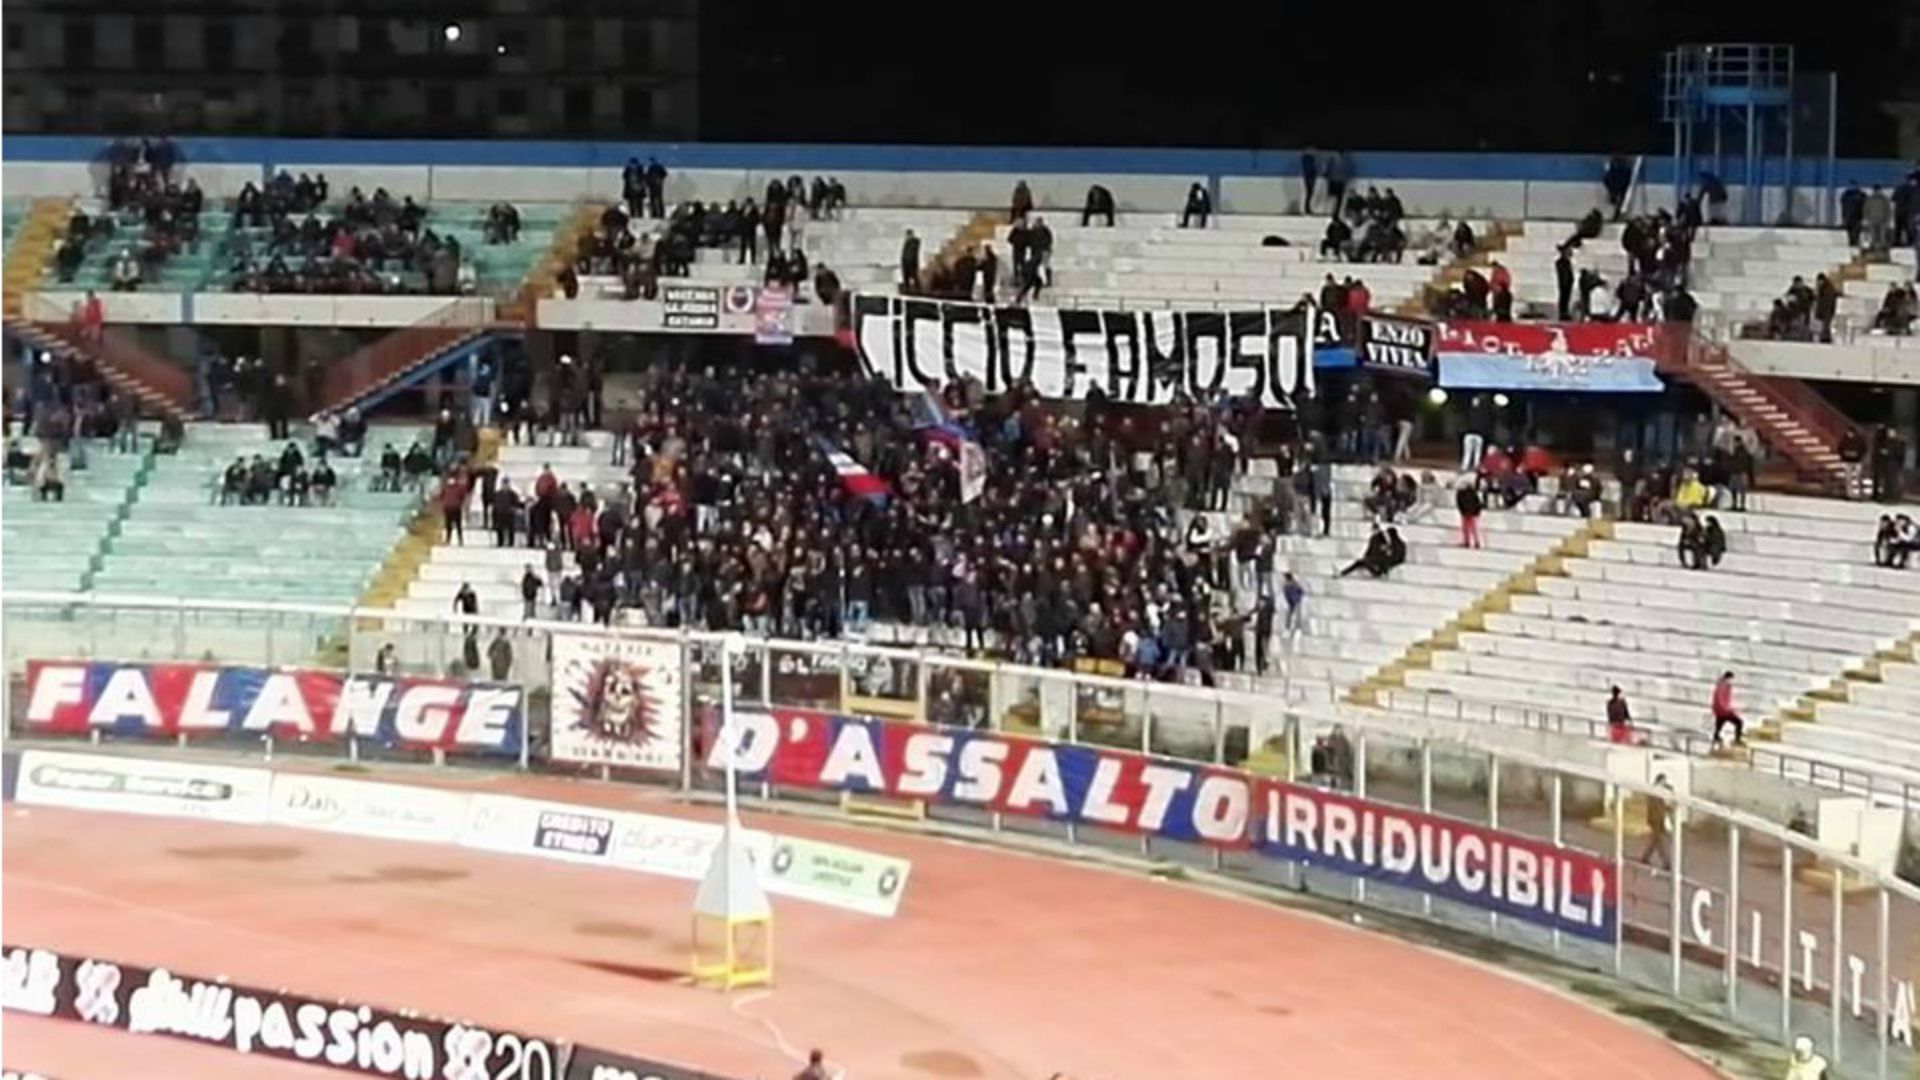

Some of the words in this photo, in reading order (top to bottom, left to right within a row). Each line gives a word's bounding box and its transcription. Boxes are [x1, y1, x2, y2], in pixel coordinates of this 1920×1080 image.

[1060, 308, 1308, 408] FAMOSO
[1371, 320, 1425, 348] ENZO
[27, 666, 521, 745] FALANGE
[708, 714, 1250, 842] D'ASSALTO
[540, 813, 611, 837] CREDITO
[1266, 788, 1606, 926] IRRIDUCIBILI
